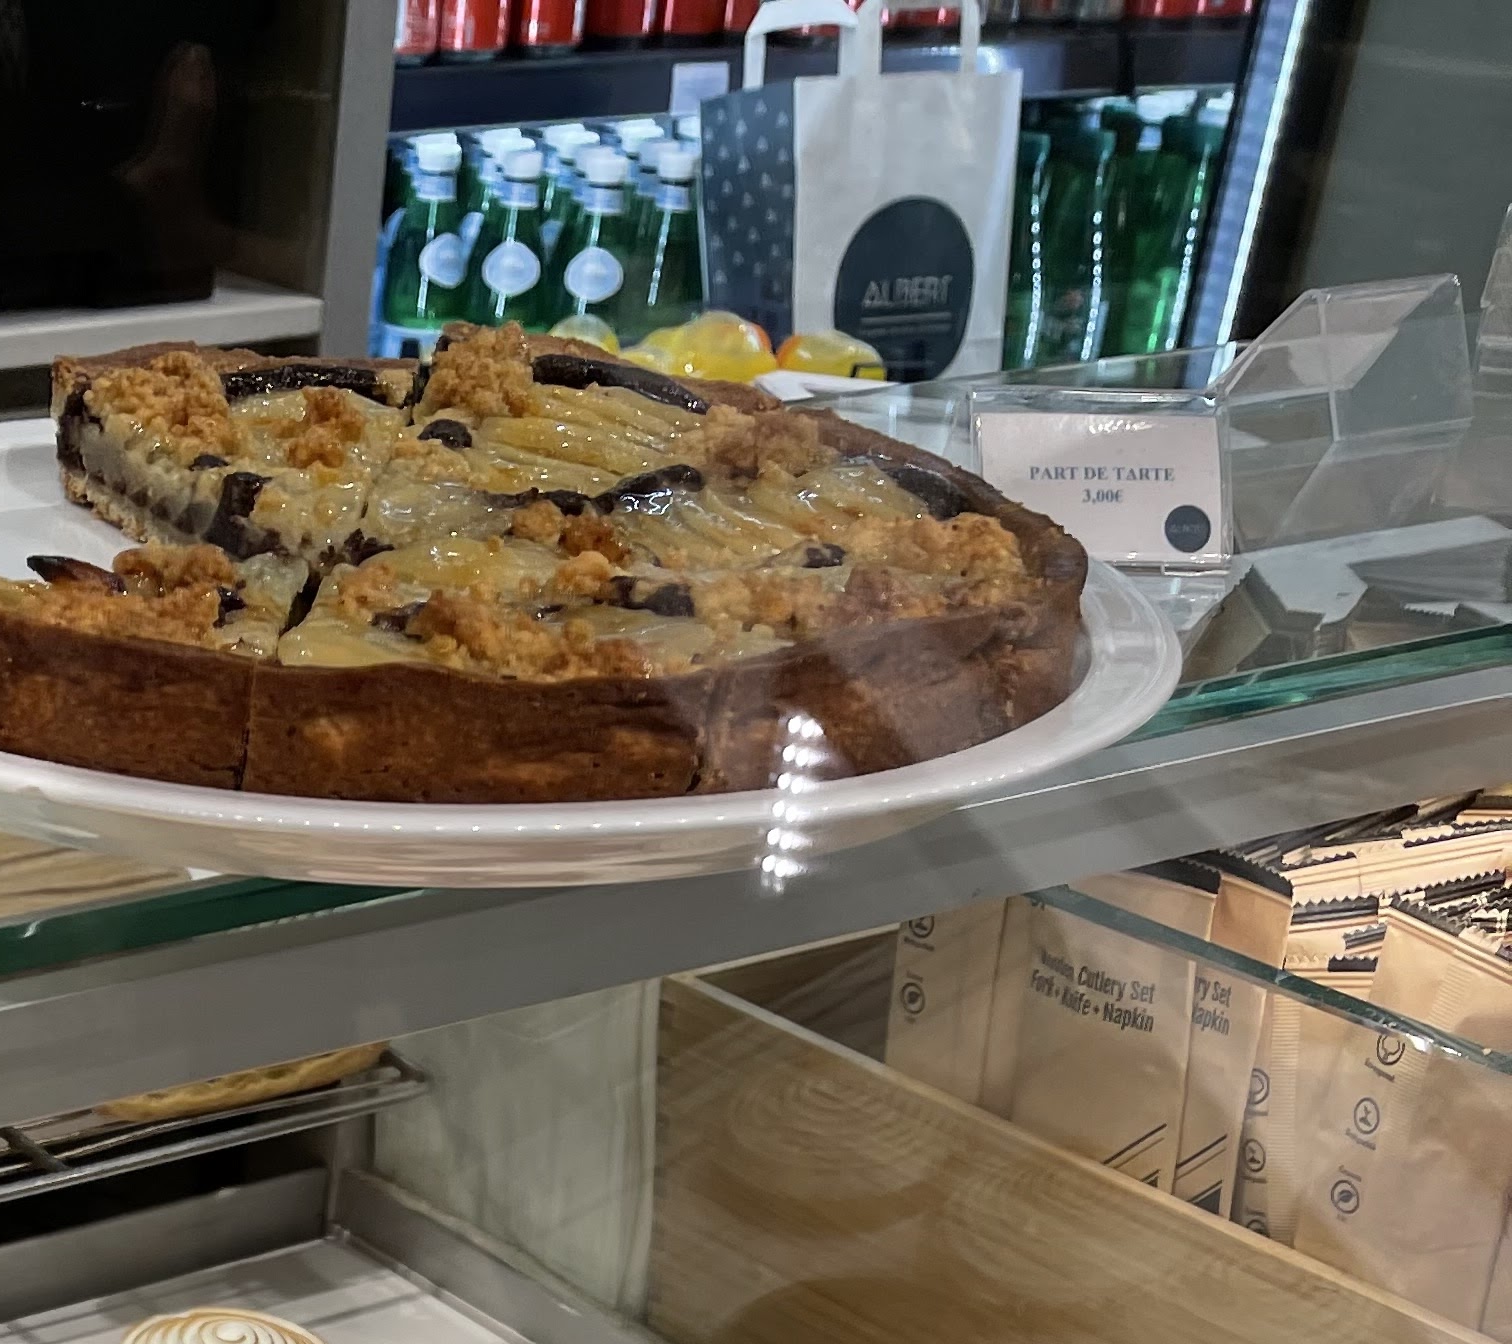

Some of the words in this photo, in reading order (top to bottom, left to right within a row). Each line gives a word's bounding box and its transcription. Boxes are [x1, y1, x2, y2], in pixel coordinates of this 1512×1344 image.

[1029, 466, 1078, 480] PART
[1084, 467, 1108, 480] DE
[1114, 467, 1175, 482] TARTE
[1082, 489, 1123, 504] 3,00€
[1077, 966, 1126, 1002] Cutlery
[1130, 980, 1155, 1004] Set
[1211, 981, 1232, 1008] Set
[1103, 1001, 1154, 1033] Napkin
